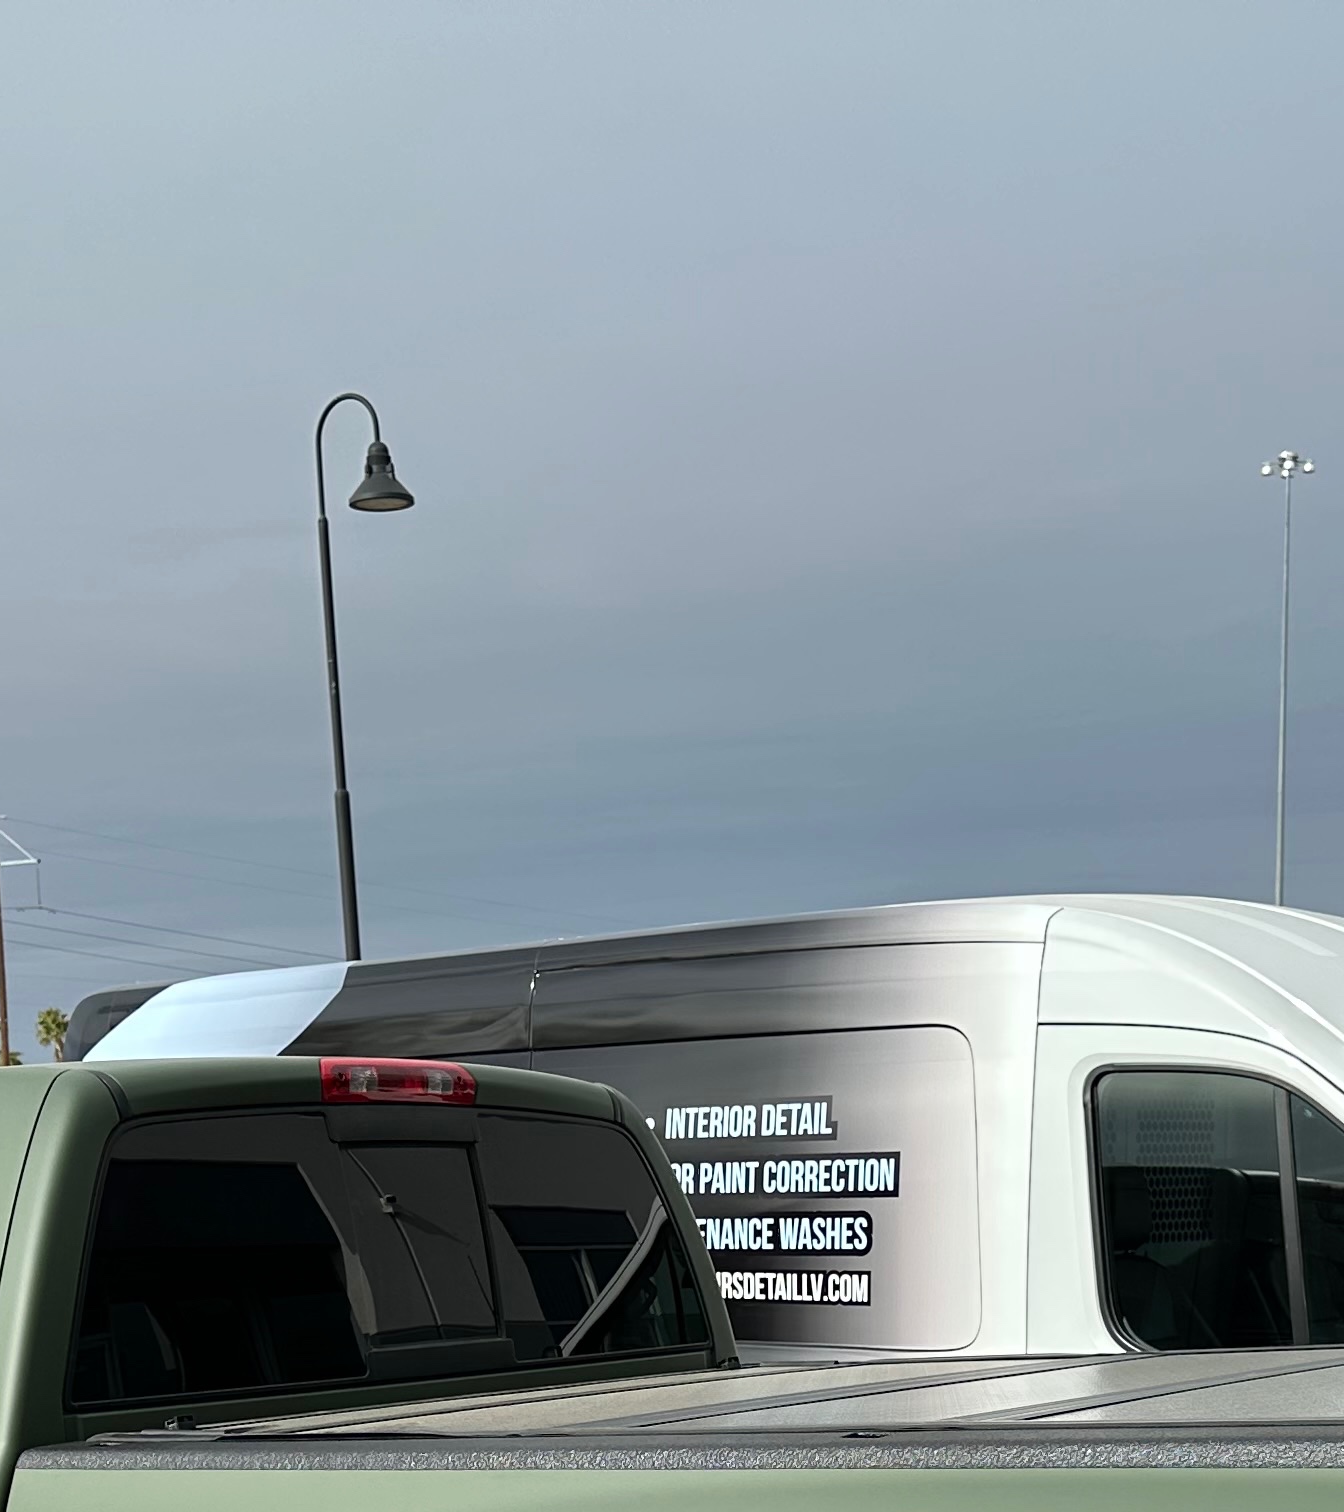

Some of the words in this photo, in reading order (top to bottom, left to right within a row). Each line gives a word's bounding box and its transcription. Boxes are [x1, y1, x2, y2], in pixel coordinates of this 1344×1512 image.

[665, 1104, 757, 1140] INTERIOR
[760, 1101, 833, 1137] DETAIL
[699, 1161, 759, 1195] PAINT
[762, 1157, 895, 1194] CORRECTION
[779, 1216, 868, 1250] WASHES
[716, 1270, 869, 1303] RSDETAILLV.COM
